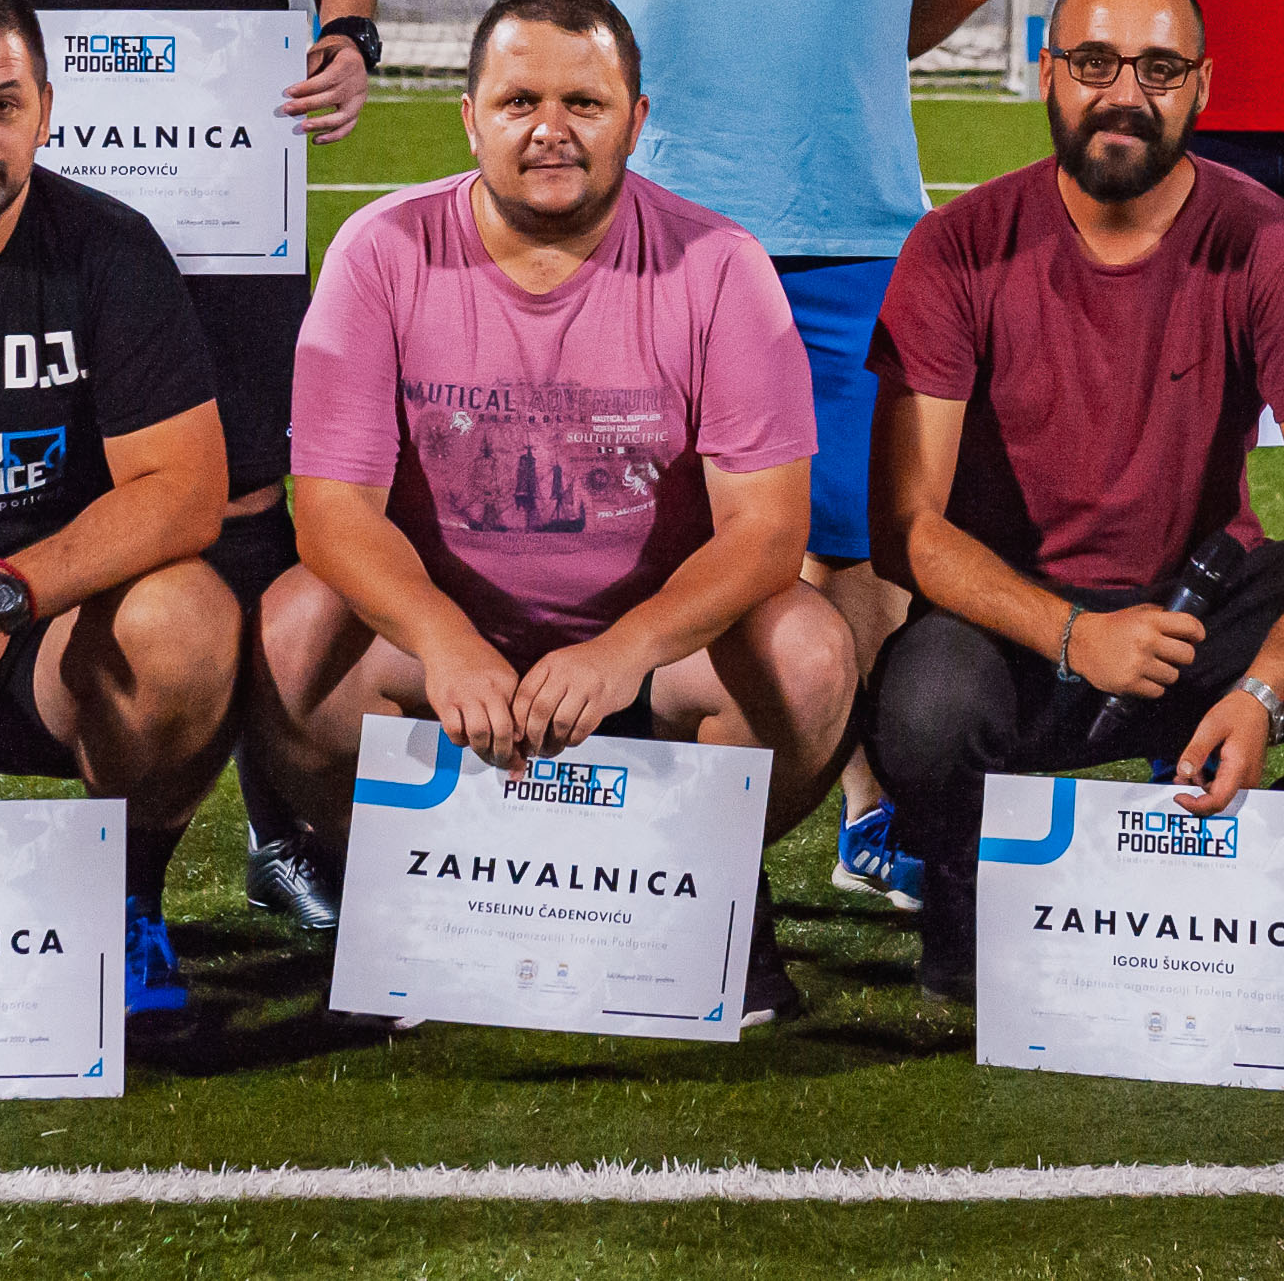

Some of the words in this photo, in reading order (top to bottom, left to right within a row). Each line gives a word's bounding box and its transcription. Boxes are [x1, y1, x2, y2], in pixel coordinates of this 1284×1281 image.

[64, 35, 143, 53] TROFEJ
[64, 56, 165, 73] PODGORICE
[46, 126, 252, 148] HVALNICA
[60, 165, 106, 176] MARKU
[111, 162, 178, 176] POPOVIĆU
[4, 330, 89, 389] D.J.
[566, 432, 611, 444] SOUTH
[616, 430, 669, 444] PACIFIC
[525, 760, 593, 783] ROFEJ
[503, 780, 614, 806] PODGORICE
[1117, 810, 1203, 834] TROFEJ
[1117, 832, 1226, 857] PODGORICE
[407, 850, 697, 898] ZAHVALNICA
[468, 900, 534, 918] VESELINU
[1112, 955, 1158, 970] IGORU
[1163, 955, 1235, 974] ŠUKOVIĆU
